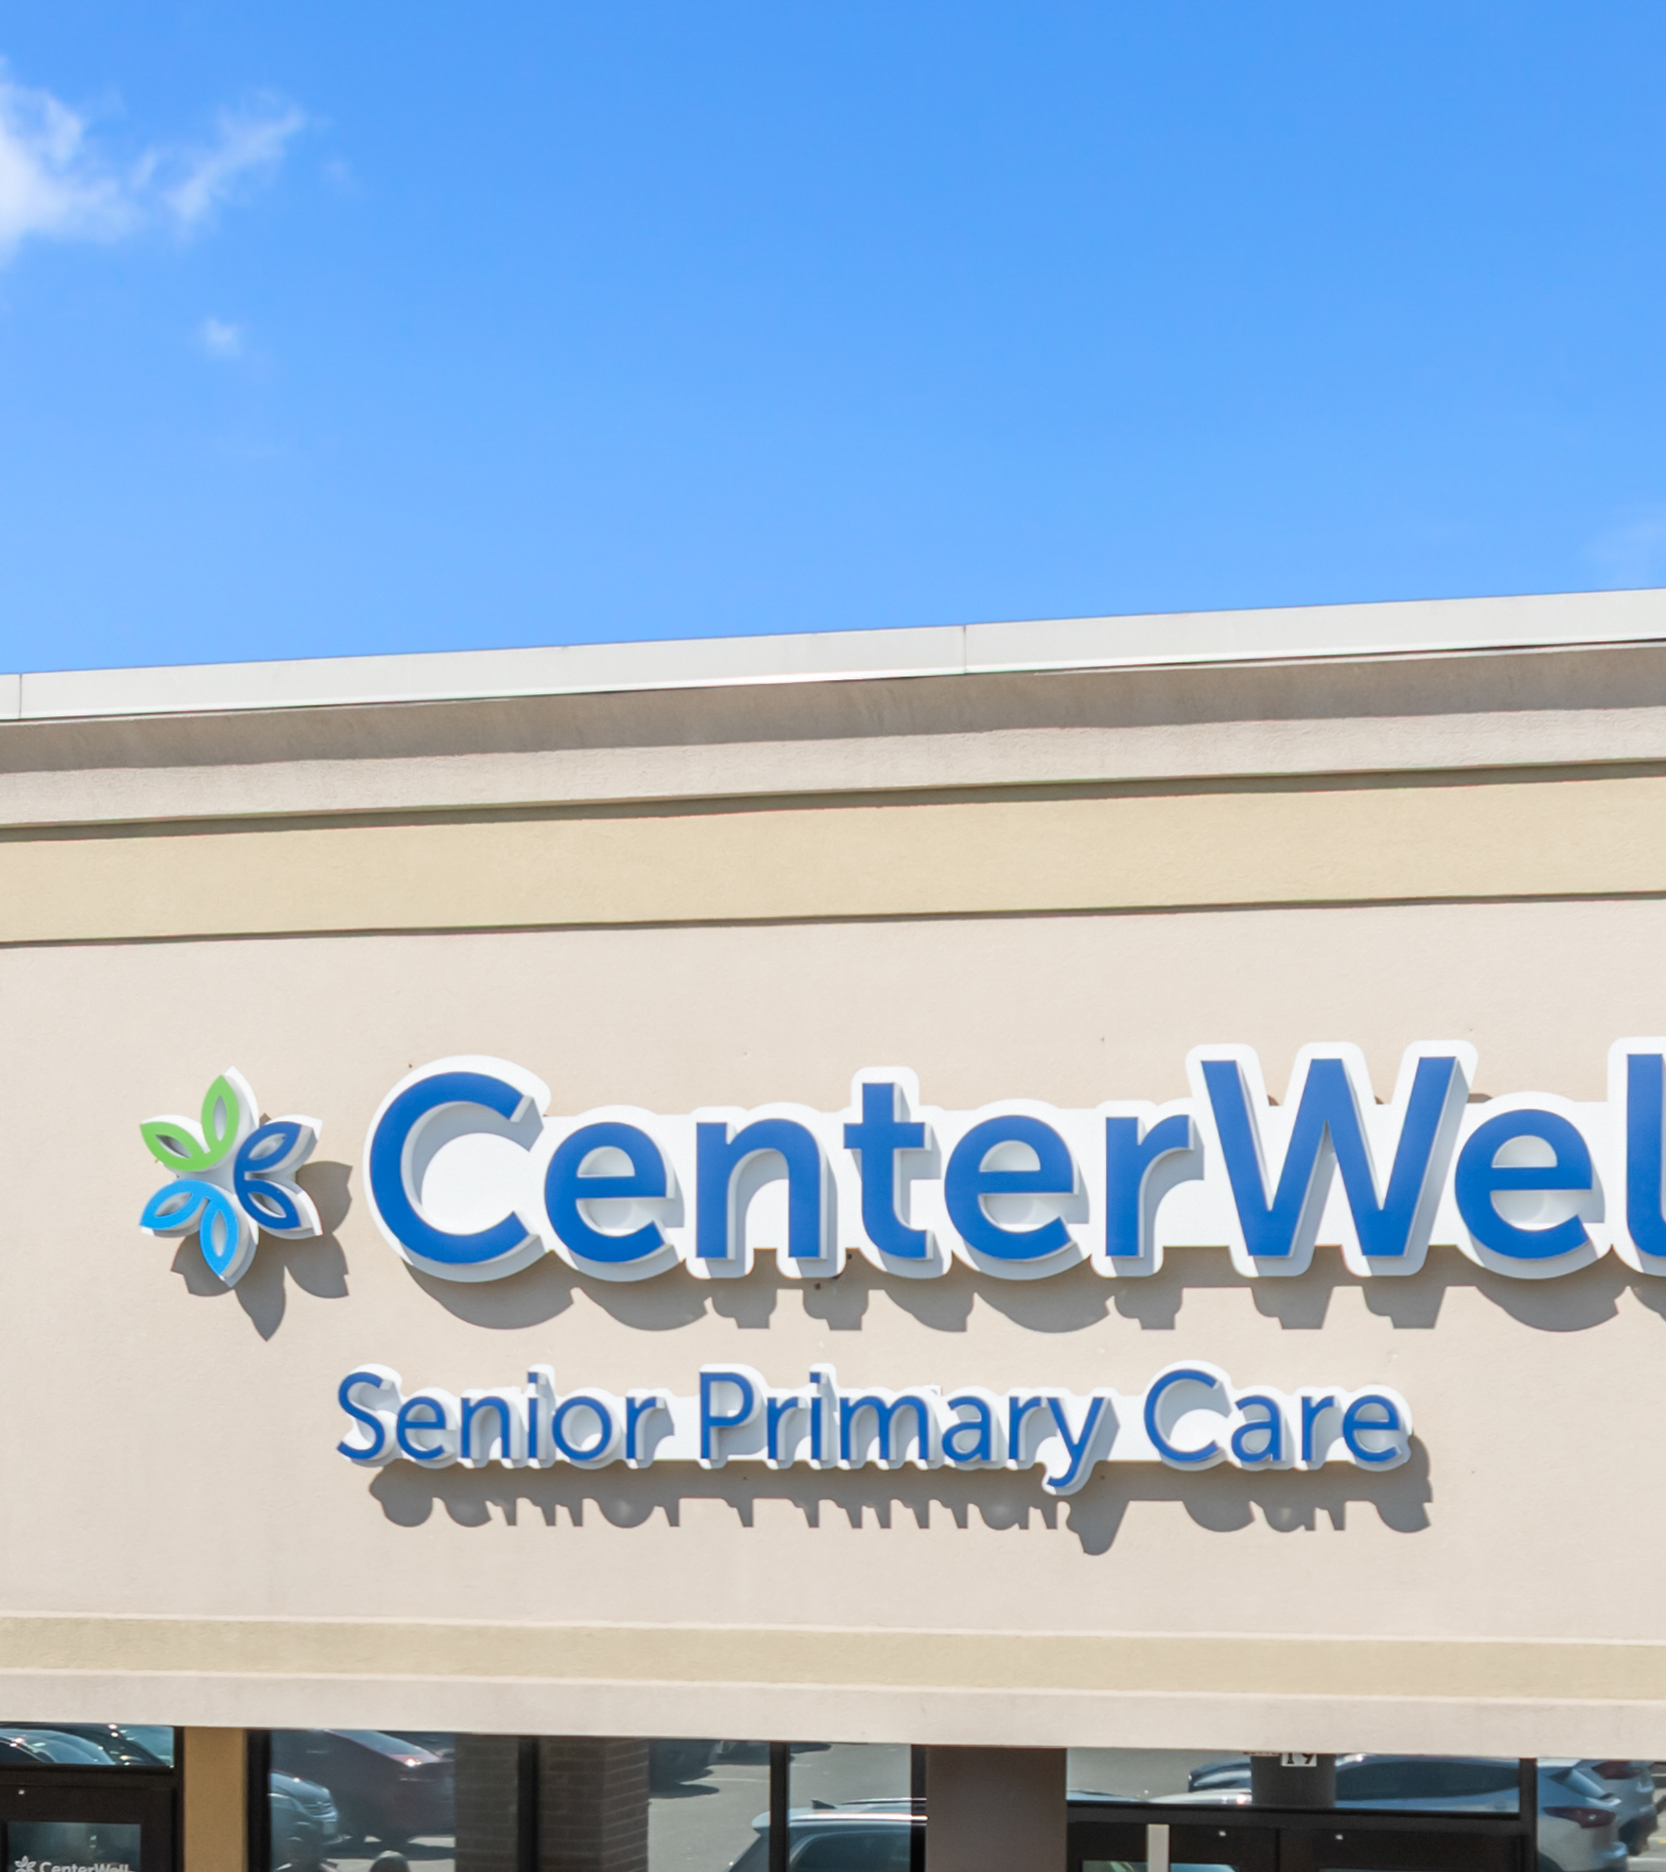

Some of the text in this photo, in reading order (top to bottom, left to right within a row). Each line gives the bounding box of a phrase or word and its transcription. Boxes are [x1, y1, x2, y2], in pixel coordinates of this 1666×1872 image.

[337, 1367, 1400, 1488] Senior Primary Care
